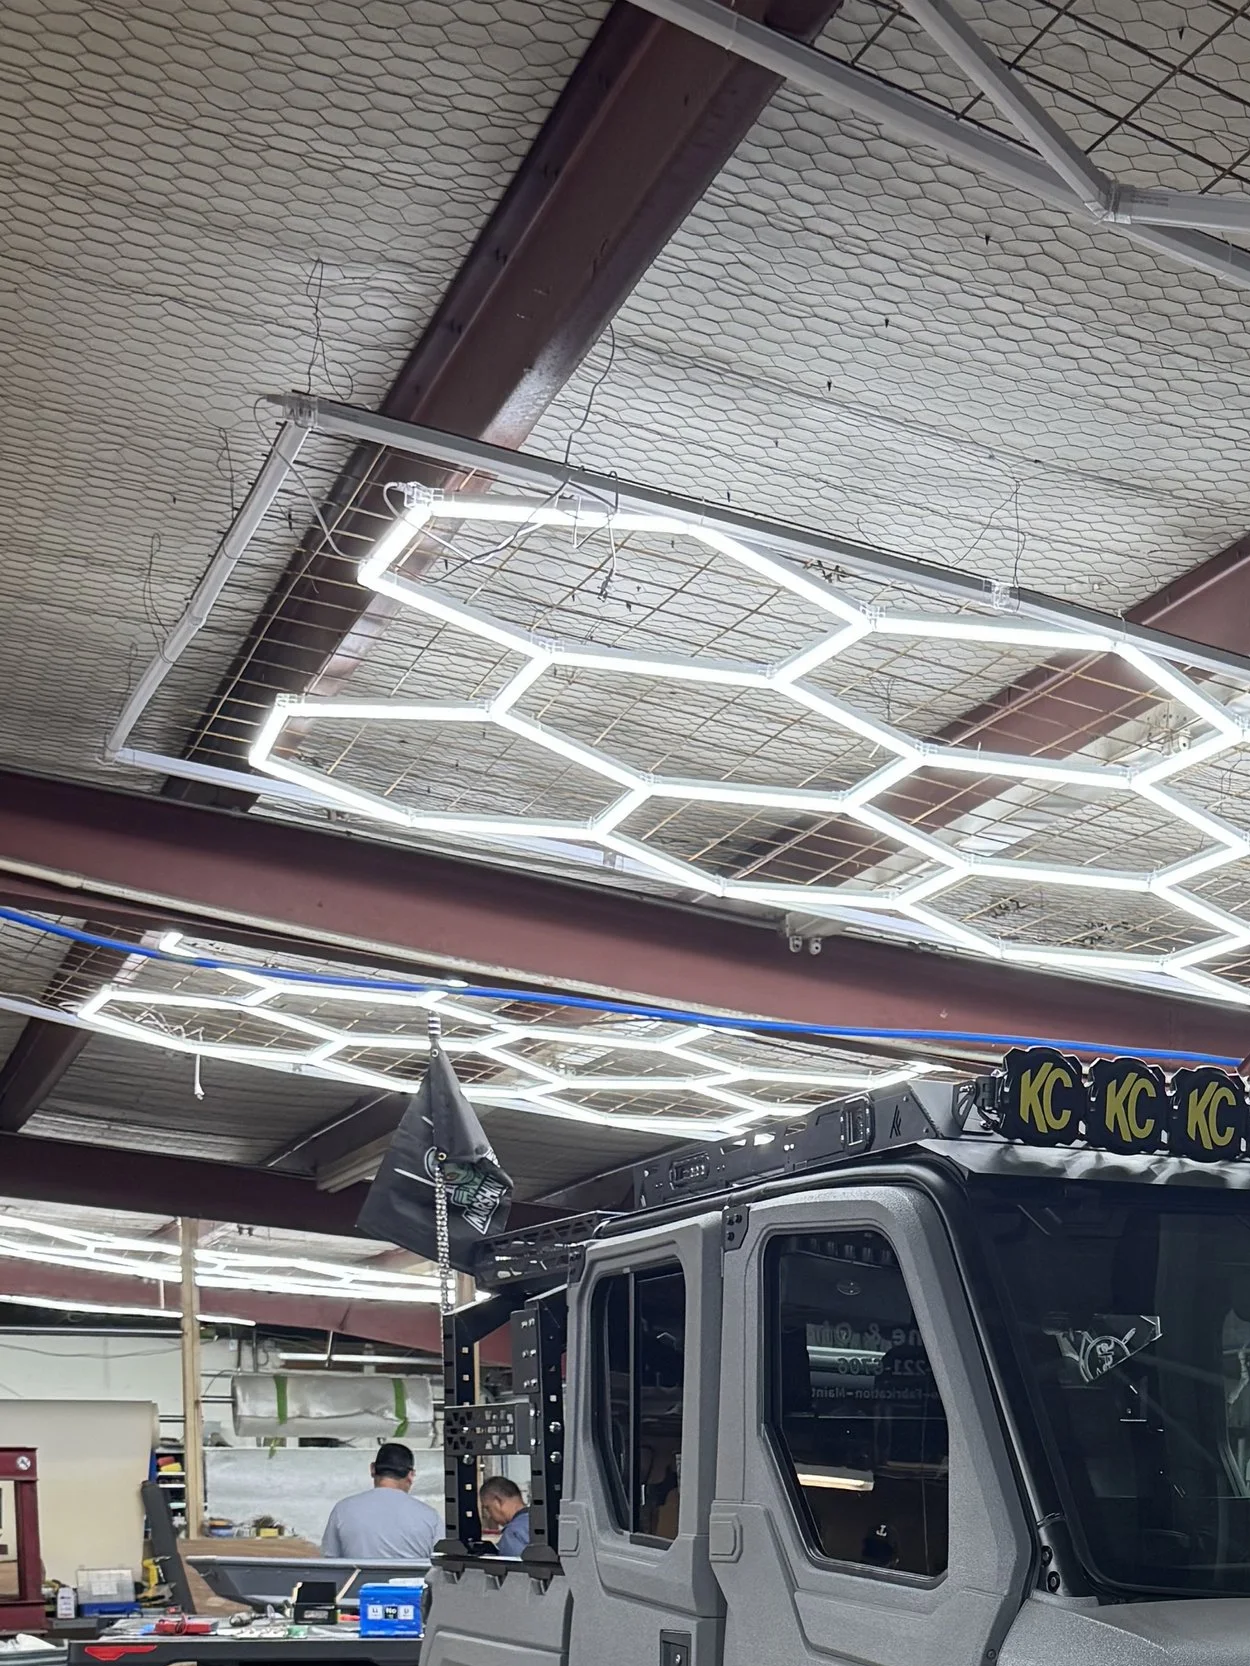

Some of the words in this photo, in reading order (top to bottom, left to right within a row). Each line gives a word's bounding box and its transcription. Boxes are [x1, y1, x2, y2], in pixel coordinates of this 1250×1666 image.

[1020, 1063, 1071, 1133] KC
[1106, 1073, 1156, 1140] KC
[1187, 1082, 1235, 1148] KC
